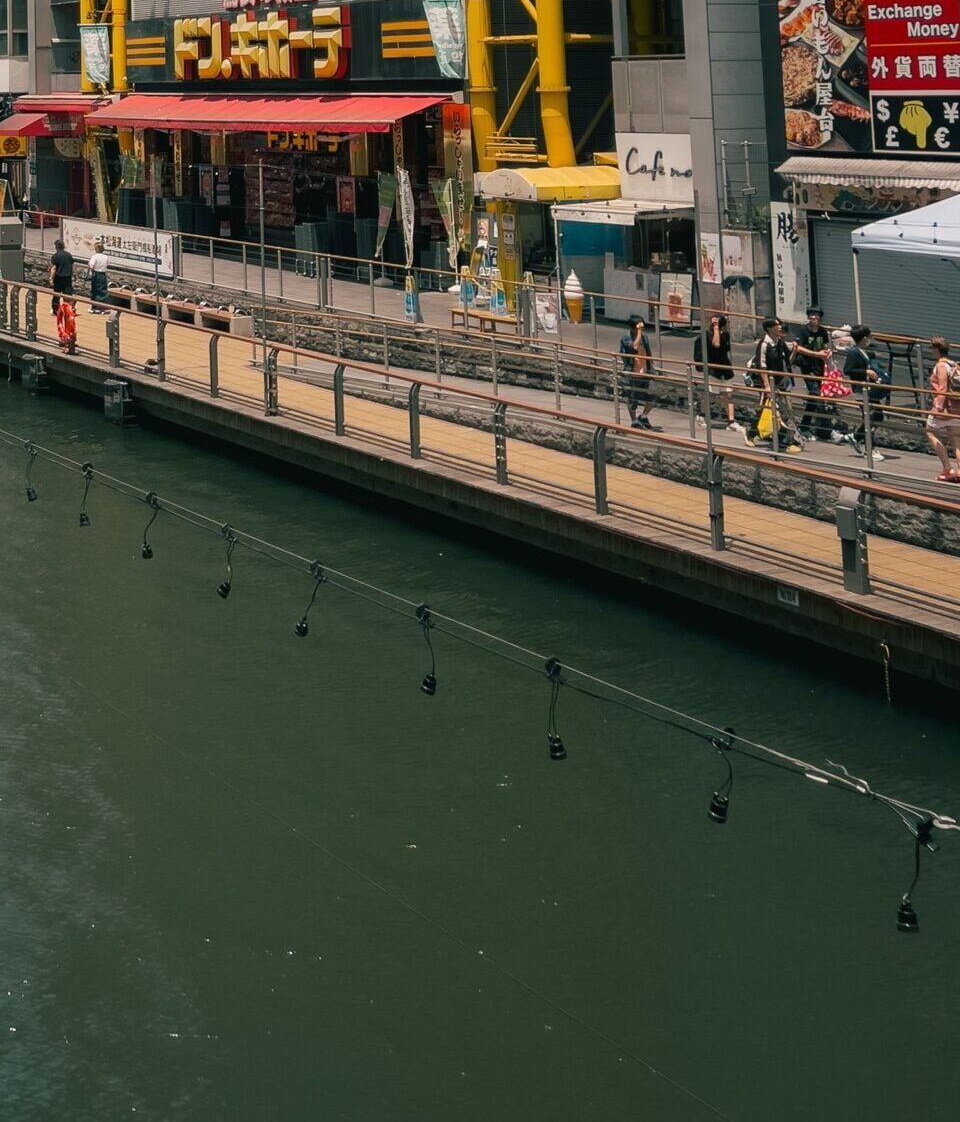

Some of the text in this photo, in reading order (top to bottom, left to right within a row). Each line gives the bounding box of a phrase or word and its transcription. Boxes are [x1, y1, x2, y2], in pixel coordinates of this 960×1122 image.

[867, 4, 943, 21] Exchange
[907, 21, 960, 38] Money
[871, 55, 960, 80] 外貨両替
[625, 146, 666, 182] Cafe
